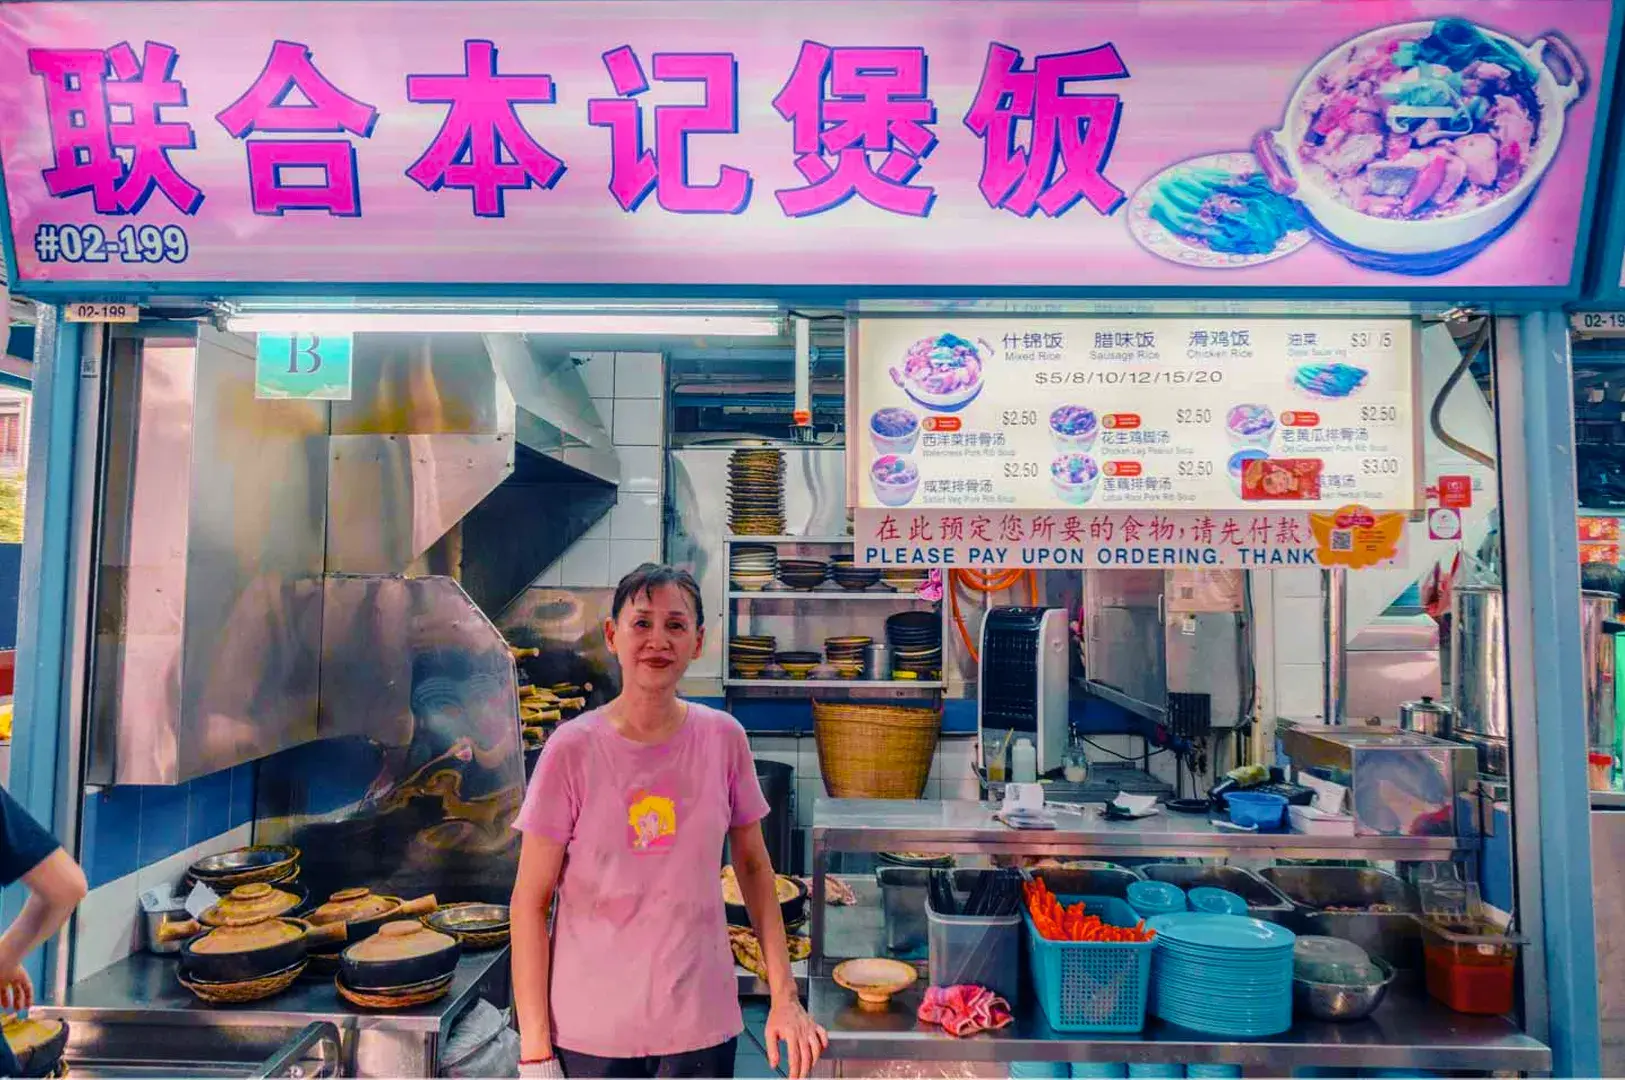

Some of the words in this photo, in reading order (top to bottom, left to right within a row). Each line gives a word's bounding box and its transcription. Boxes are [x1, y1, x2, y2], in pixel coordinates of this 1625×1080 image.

[28, 39, 1131, 218] 联合本记煲饭
[35, 224, 189, 263] #02-199
[78, 305, 126, 318] 02-199
[1002, 332, 1064, 349] 什锦饭
[1094, 332, 1156, 348] 腊味饭
[1188, 330, 1251, 347] 滑鸡饭
[286, 332, 322, 374] B
[1005, 351, 1035, 361] Mixed
[1039, 351, 1062, 361] Rice
[1089, 351, 1134, 362] Sausage
[1137, 351, 1160, 360] Rice
[1186, 349, 1227, 359] Chicken
[1230, 348, 1254, 358] Rice
[1035, 371, 1223, 385] $5/8/10/12/15/20
[1002, 410, 1037, 426] $2.50
[1176, 408, 1212, 425] $2.50
[1361, 405, 1396, 421] $2.50
[922, 432, 1006, 446] 西洋菜排骨汤
[1281, 428, 1368, 442] 老黄瓜排骨汤
[1003, 462, 1038, 478] $2.50
[1178, 460, 1214, 476] $2.50
[1361, 458, 1398, 474] $3.00
[923, 479, 993, 493] 咸菜排骨汤
[1103, 477, 1172, 491] 莲藕排骨汤
[866, 547, 955, 564] PLEASE
[969, 547, 1009, 564] PAY
[1022, 547, 1084, 564] UPON
[1097, 547, 1225, 565] ORDERING.
[1238, 547, 1316, 564] THANK
